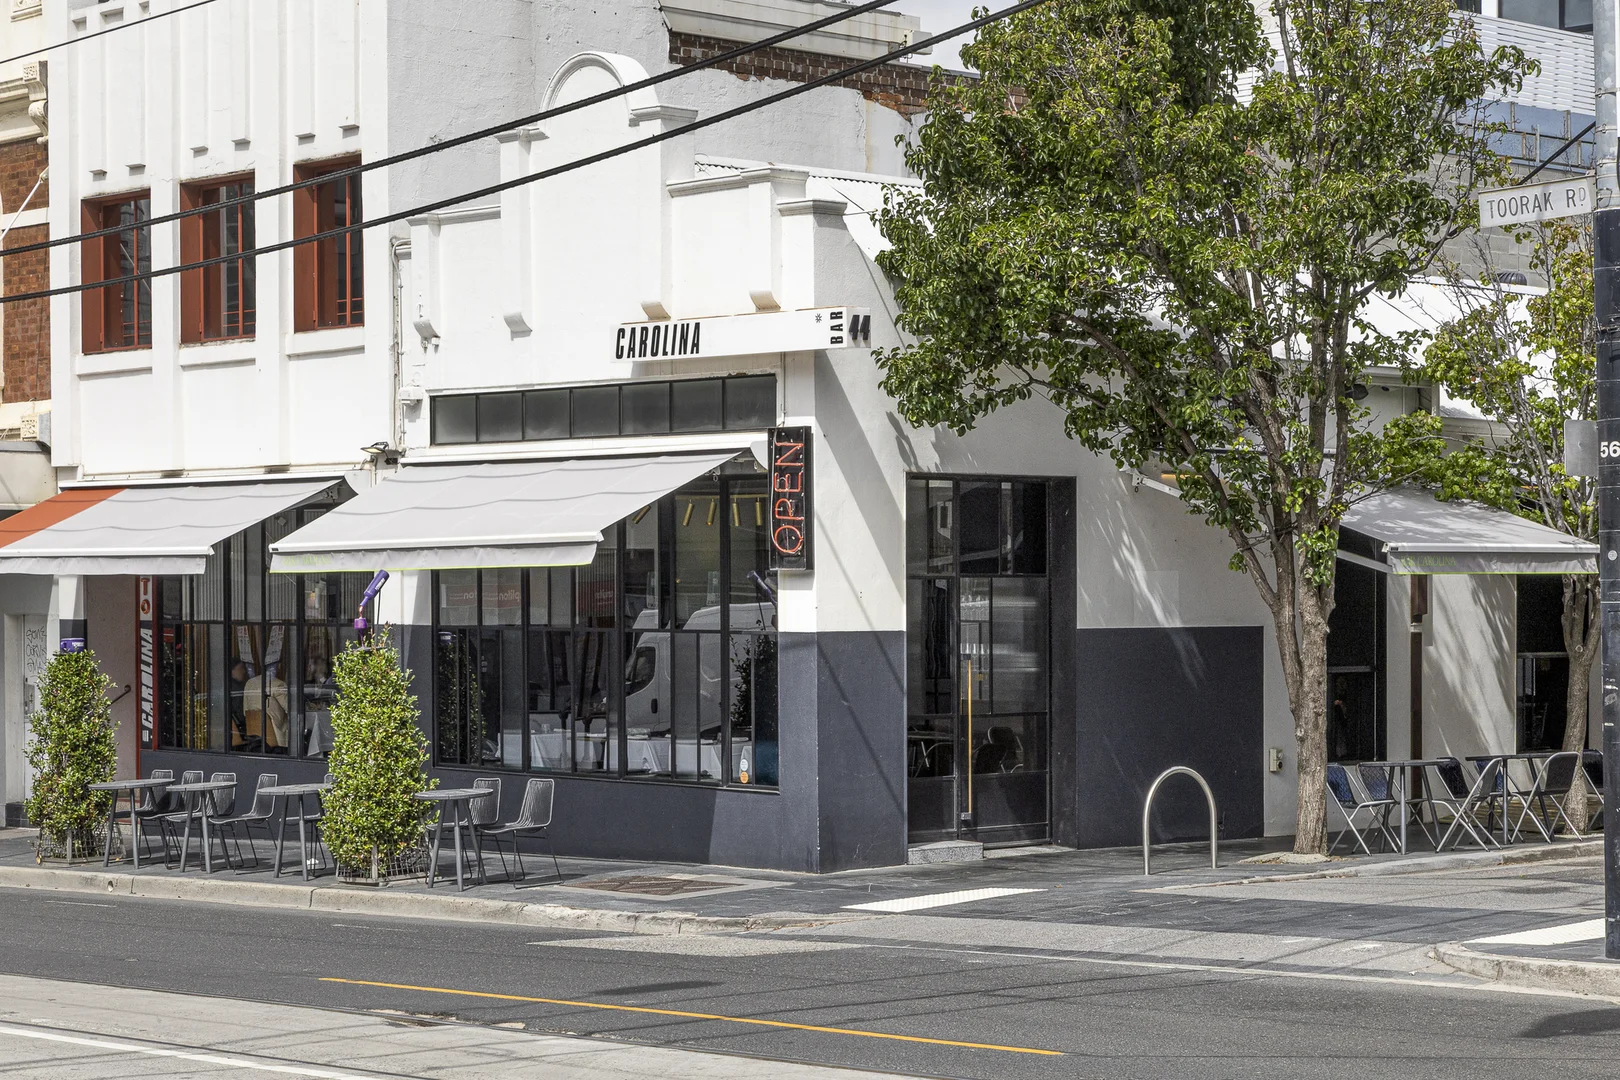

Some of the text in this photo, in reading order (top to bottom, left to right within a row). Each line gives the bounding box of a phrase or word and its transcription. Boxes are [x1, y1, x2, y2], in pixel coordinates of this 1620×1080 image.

[1487, 192, 1554, 219] TOORAK
[615, 322, 700, 359] CAROLINA
[830, 311, 843, 344] BAR
[849, 315, 871, 340] 44
[774, 442, 804, 553] OPEN
[141, 628, 153, 729] CAROLINA
